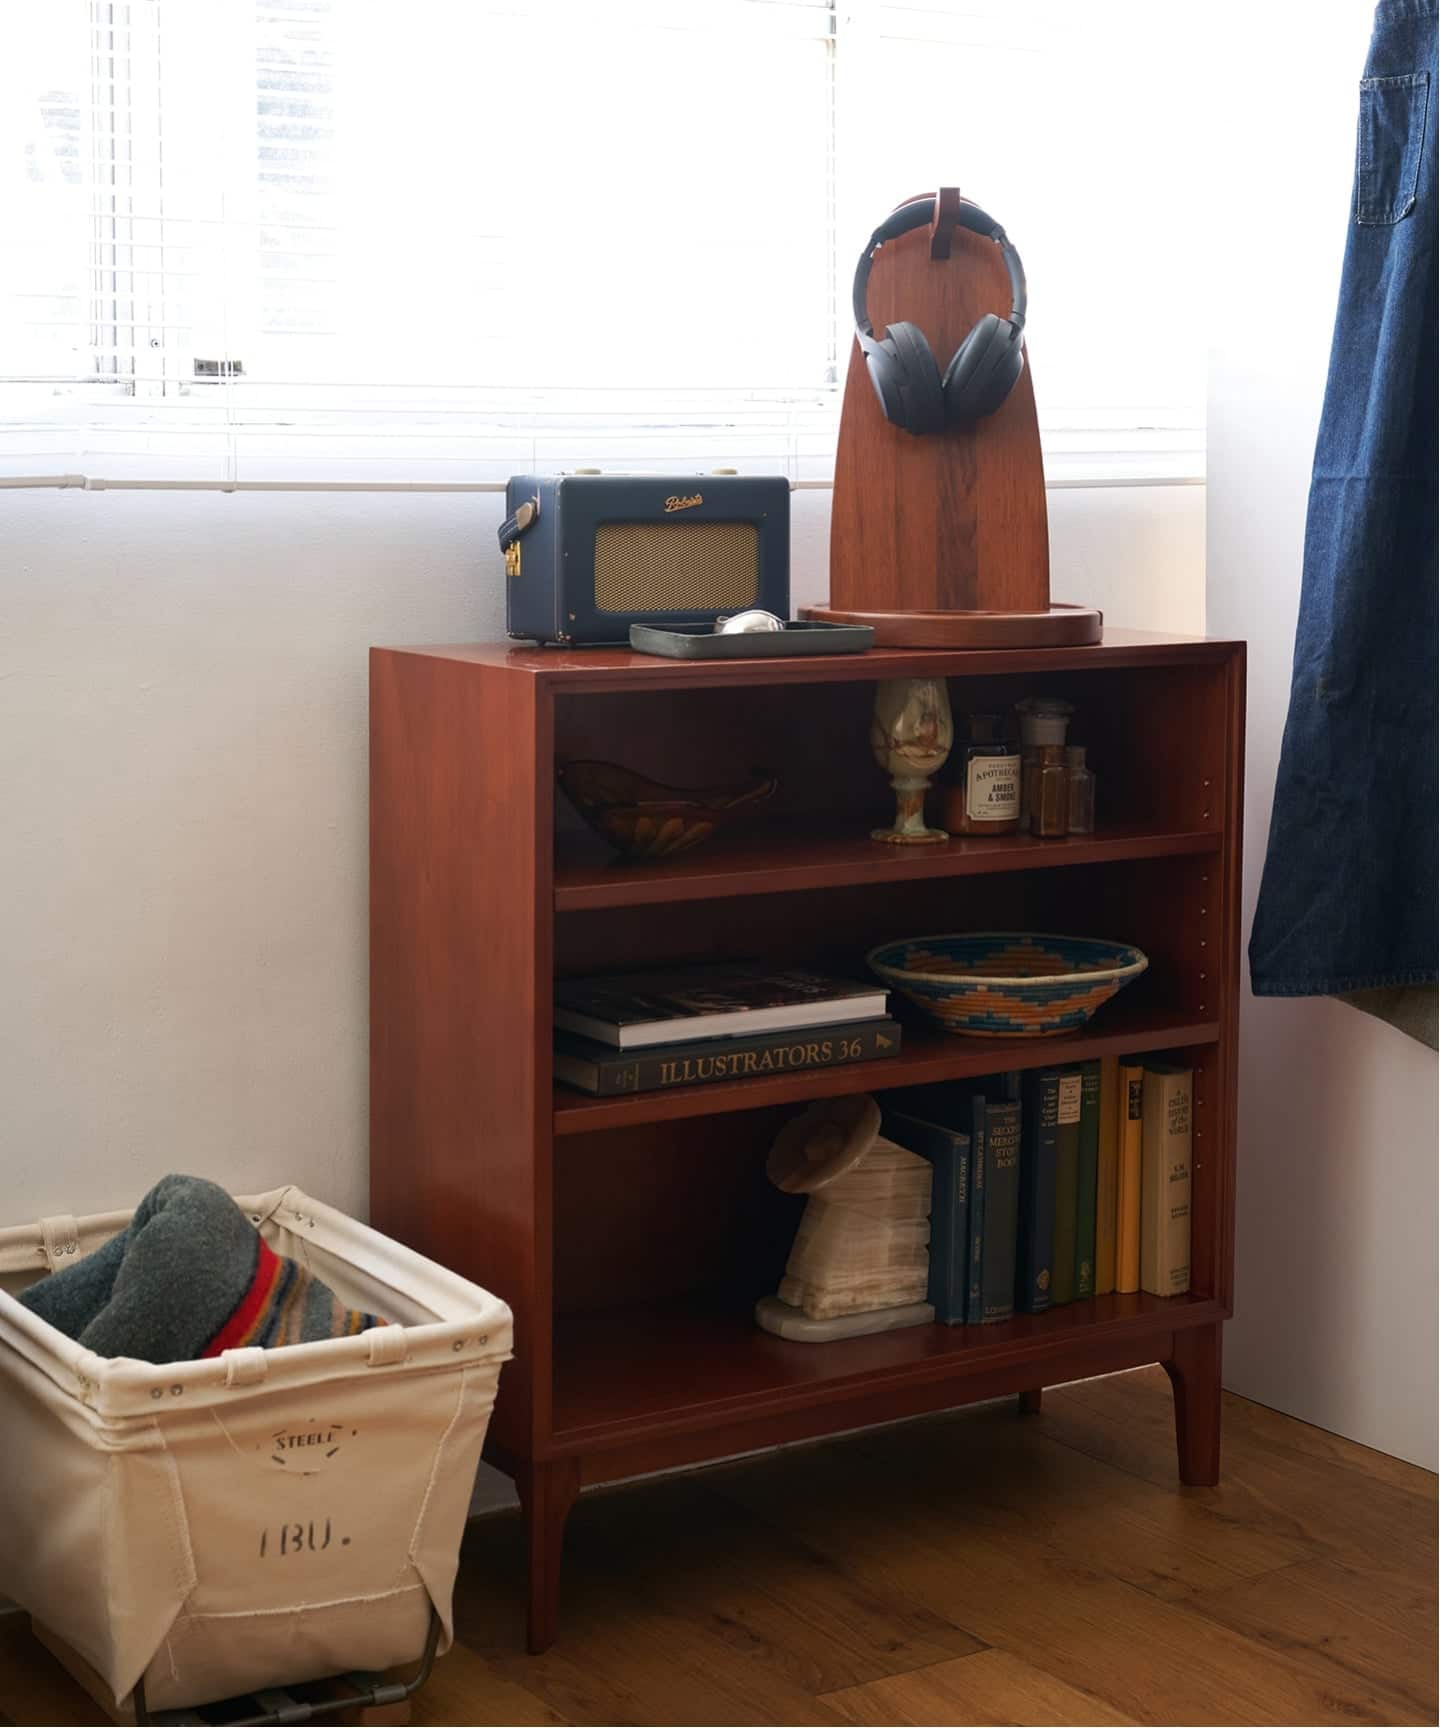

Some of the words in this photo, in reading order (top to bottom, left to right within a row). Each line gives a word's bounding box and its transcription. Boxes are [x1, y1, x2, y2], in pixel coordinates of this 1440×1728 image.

[992, 784, 1014, 793] AMBER
[658, 1040, 834, 1085] ILLUSTRATORS
[839, 1037, 862, 1060] 36
